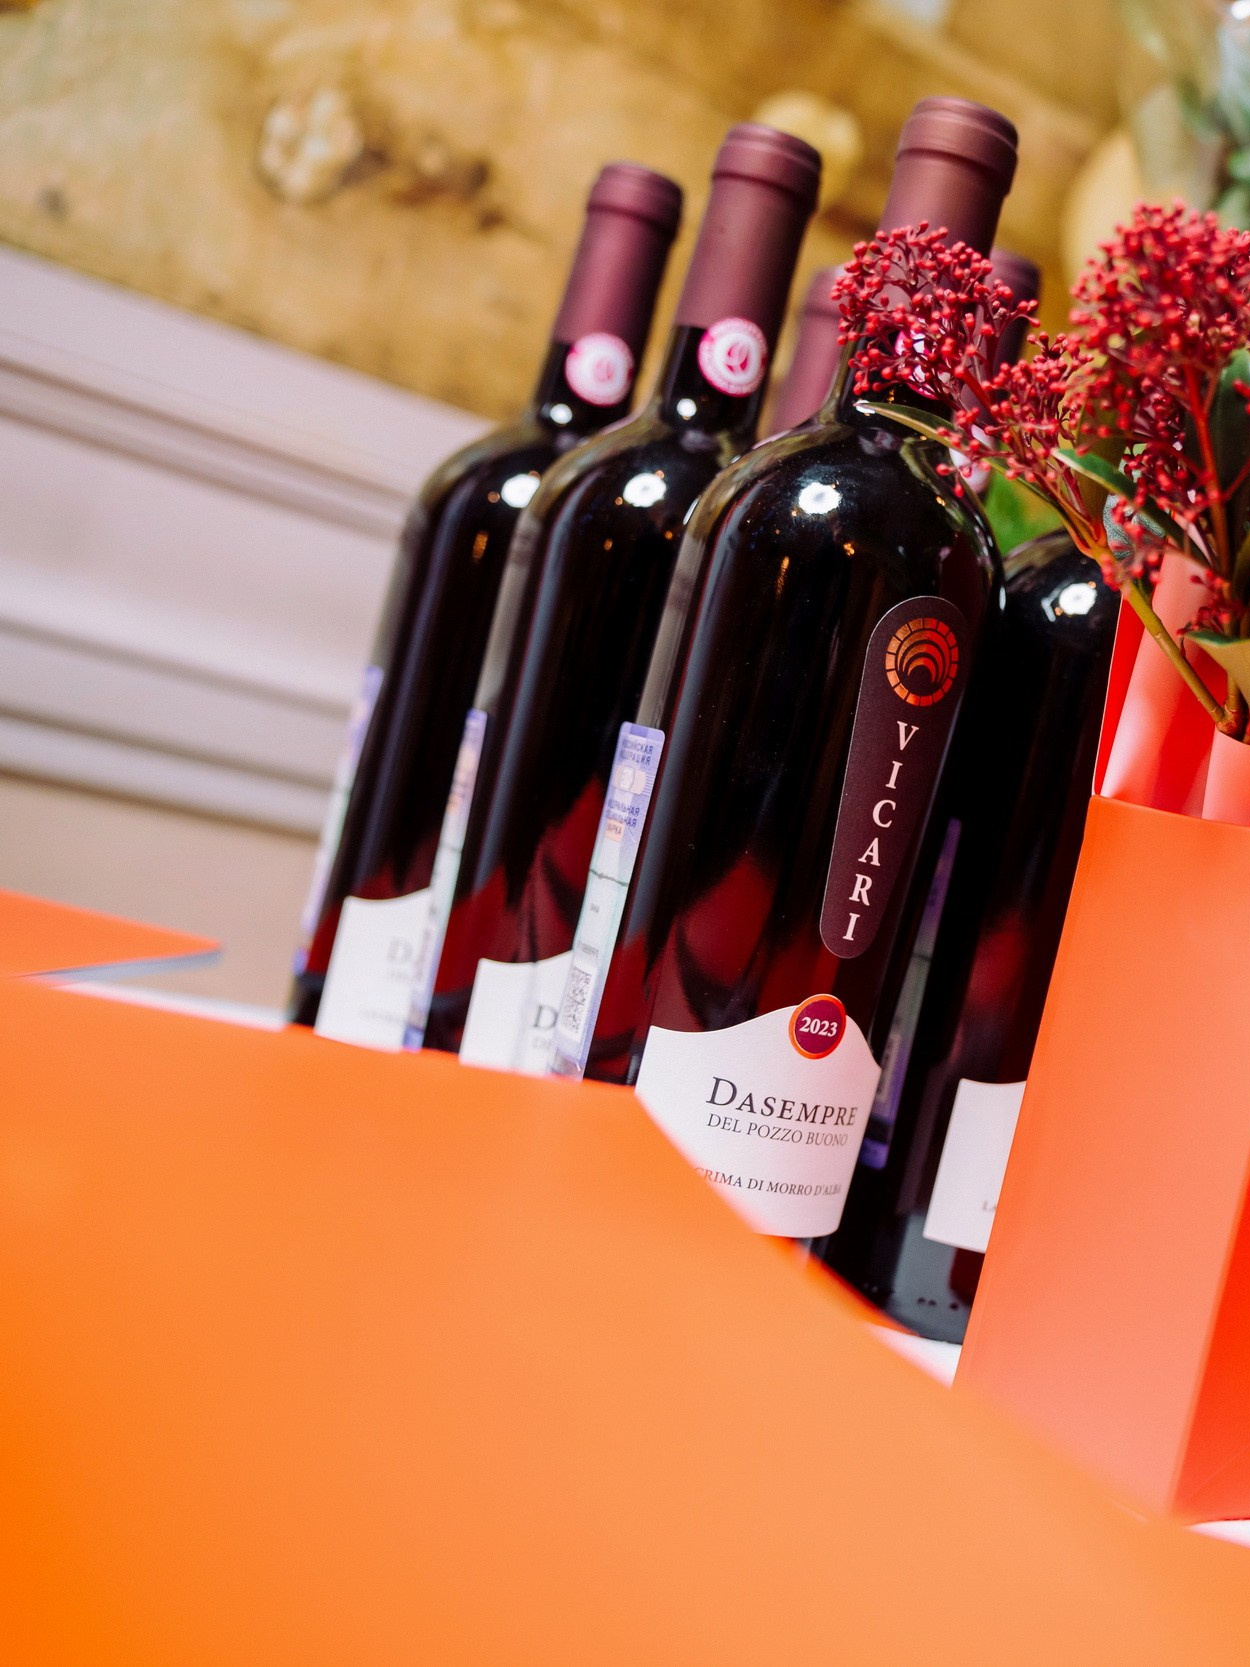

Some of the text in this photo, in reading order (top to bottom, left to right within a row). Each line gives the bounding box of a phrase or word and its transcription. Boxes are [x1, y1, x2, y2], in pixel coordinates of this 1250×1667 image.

[843, 720, 919, 941] VICARI
[799, 1016, 838, 1037] 2023
[705, 1076, 859, 1127] DASEMPRE
[707, 1113, 849, 1147] DEL POZZO BUONO
[747, 1178, 765, 1191] DI
[766, 1181, 813, 1196] MORRO
